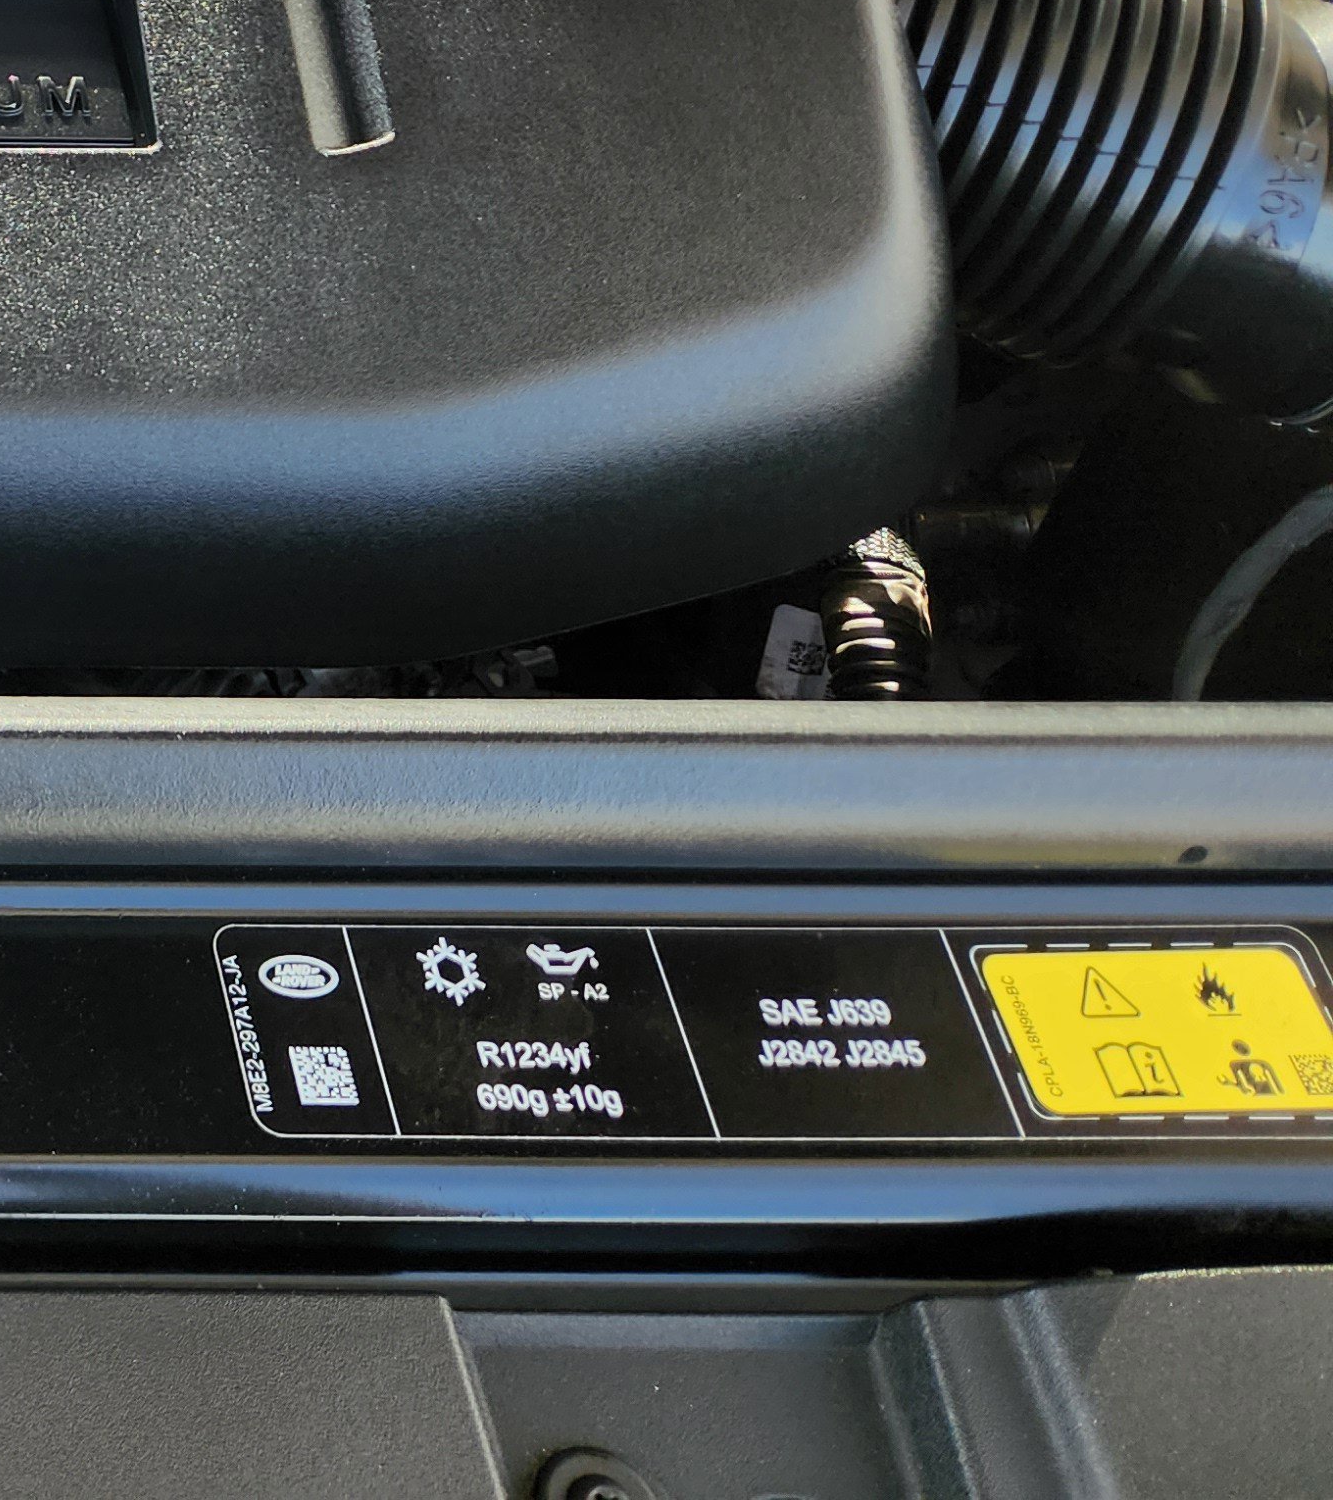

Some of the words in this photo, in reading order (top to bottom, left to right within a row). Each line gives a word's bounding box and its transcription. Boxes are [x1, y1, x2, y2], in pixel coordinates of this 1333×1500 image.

[274, 964, 311, 975] LAND
[280, 974, 326, 988] ROVER
[538, 983, 565, 1000] SP
[584, 983, 610, 1000] A2
[759, 999, 823, 1026] SAE
[827, 999, 892, 1026] J639
[222, 954, 274, 1113] M8E2-297A12-JA
[1001, 975, 1063, 1097] CPLA-18N969-BC
[476, 1041, 592, 1074] R1234yf
[758, 1039, 841, 1067] J2842
[845, 1039, 927, 1067] J2845
[477, 1083, 549, 1118] 690g
[552, 1084, 624, 1118] ±10g
